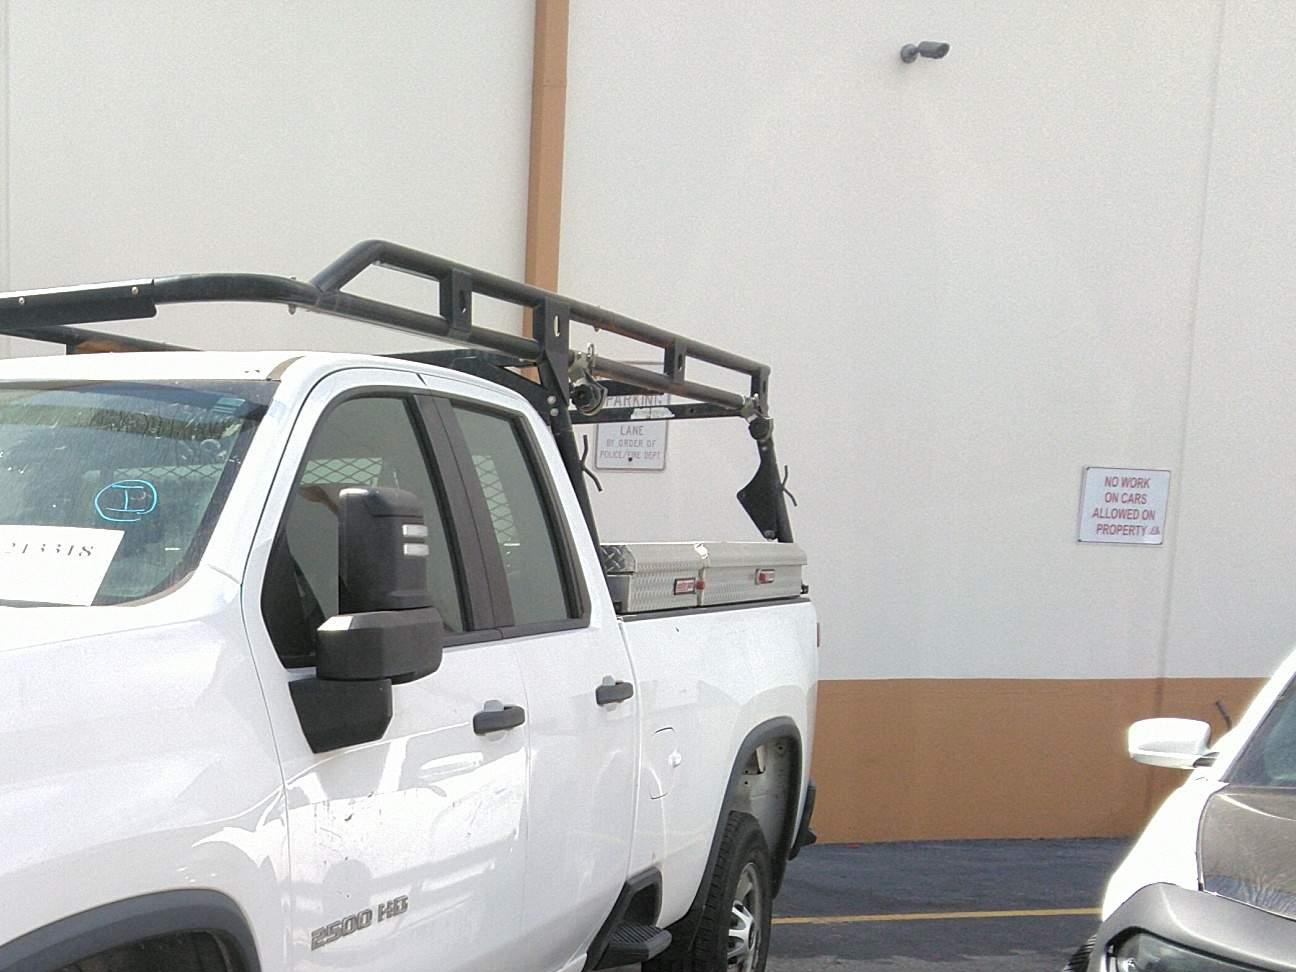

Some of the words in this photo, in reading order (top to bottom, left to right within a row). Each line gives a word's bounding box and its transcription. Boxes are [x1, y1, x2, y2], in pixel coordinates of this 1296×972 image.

[620, 425, 644, 436] LANE
[618, 439, 643, 448] ORDER
[647, 440, 657, 448] OF
[1104, 476, 1119, 488] NO
[1121, 476, 1150, 489] WORK
[1104, 491, 1119, 504] ON
[1121, 492, 1147, 505] CARS
[1092, 507, 1139, 520] ALLOWED
[1142, 509, 1155, 521] ON
[1096, 523, 1146, 536] PROPERTY
[310, 908, 373, 952] 2500
[377, 894, 409, 923] HD
